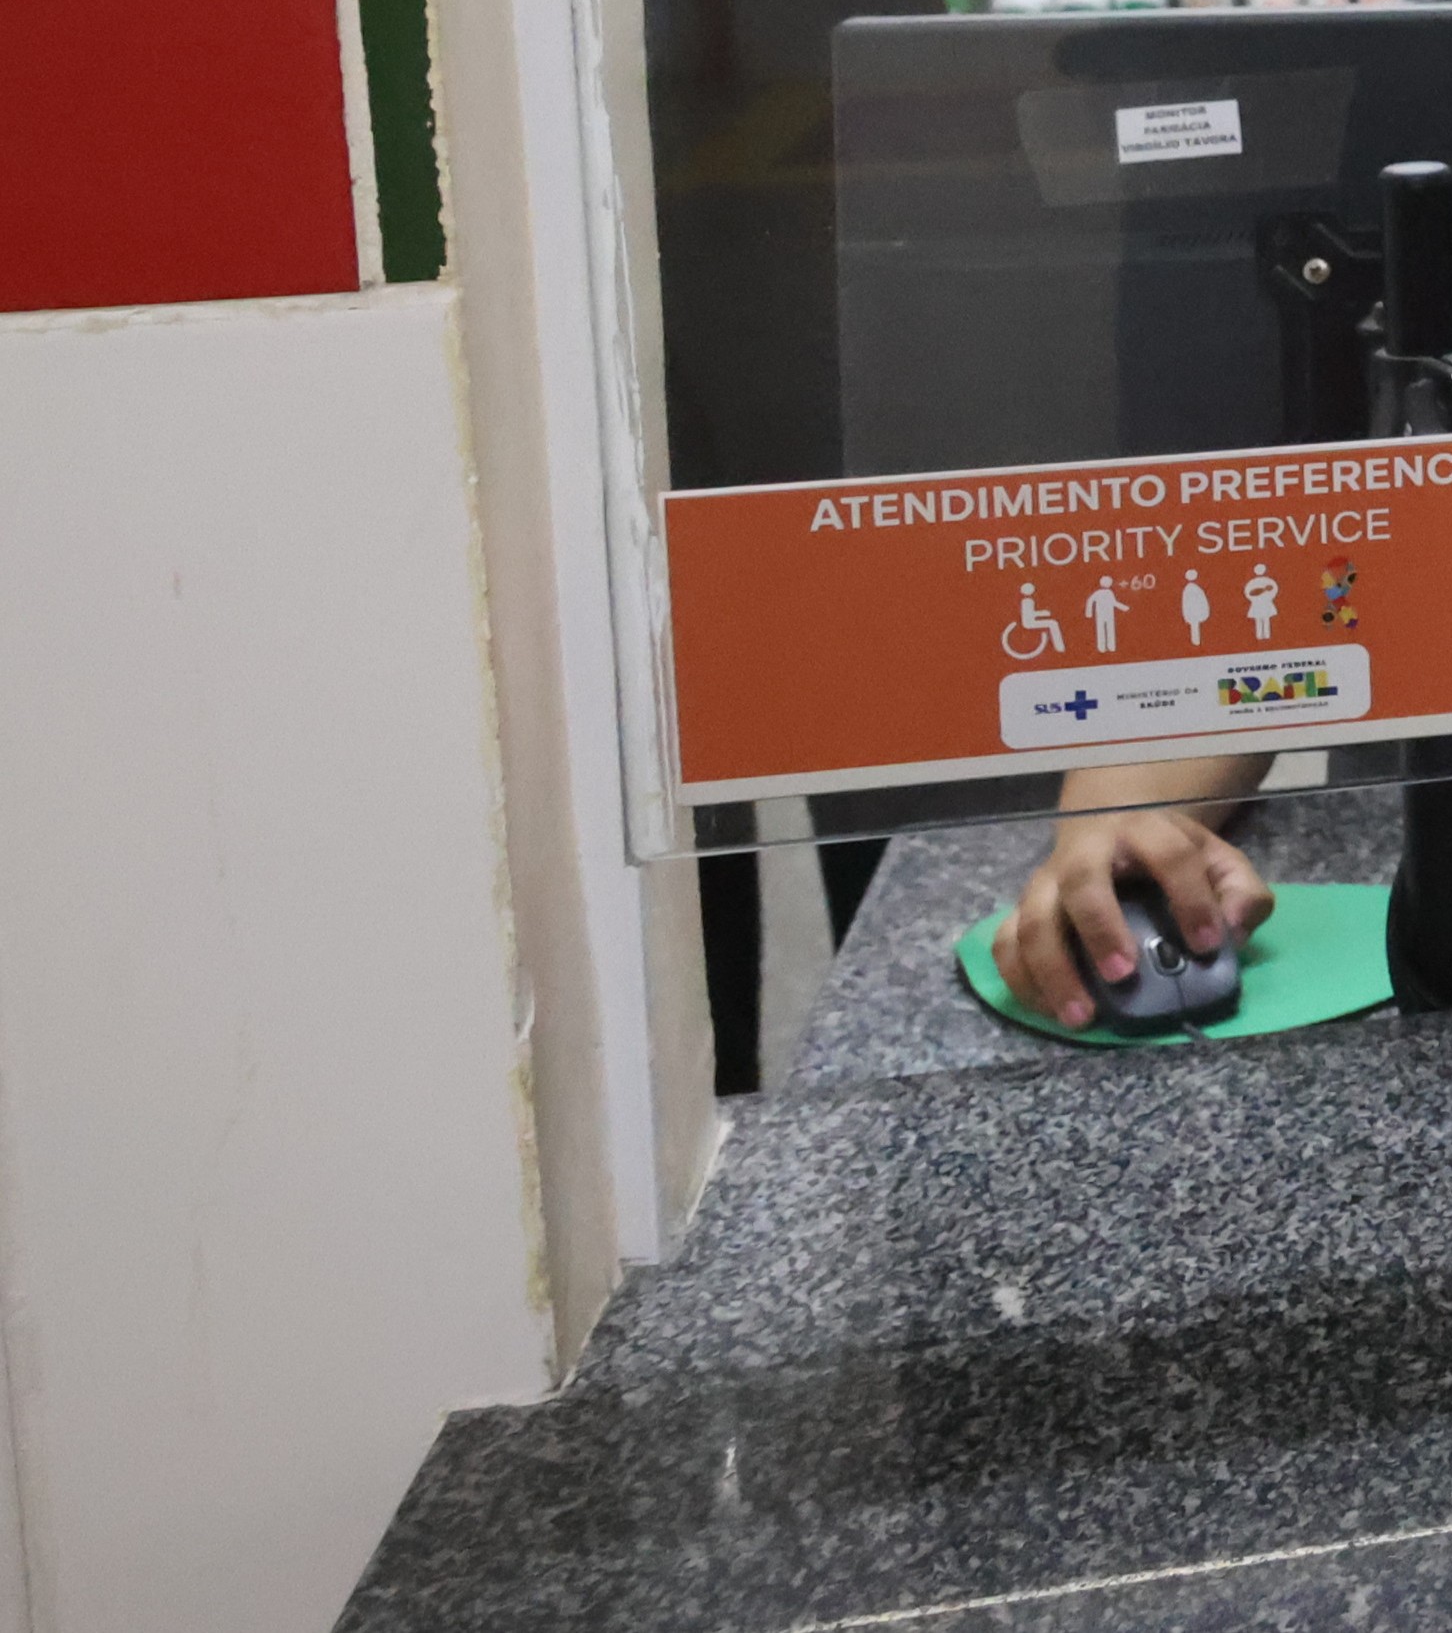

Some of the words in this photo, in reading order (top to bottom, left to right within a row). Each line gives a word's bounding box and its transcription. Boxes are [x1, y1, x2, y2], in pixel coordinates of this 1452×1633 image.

[809, 474, 1167, 533] ATENDIMENTO
[964, 524, 1184, 572] PRIORITY
[1196, 508, 1392, 555] SERVICE
[1118, 573, 1157, 592] +60
[1184, 686, 1199, 695] DA
[1218, 670, 1338, 706] BRASIL
[1034, 701, 1062, 716] SUS
